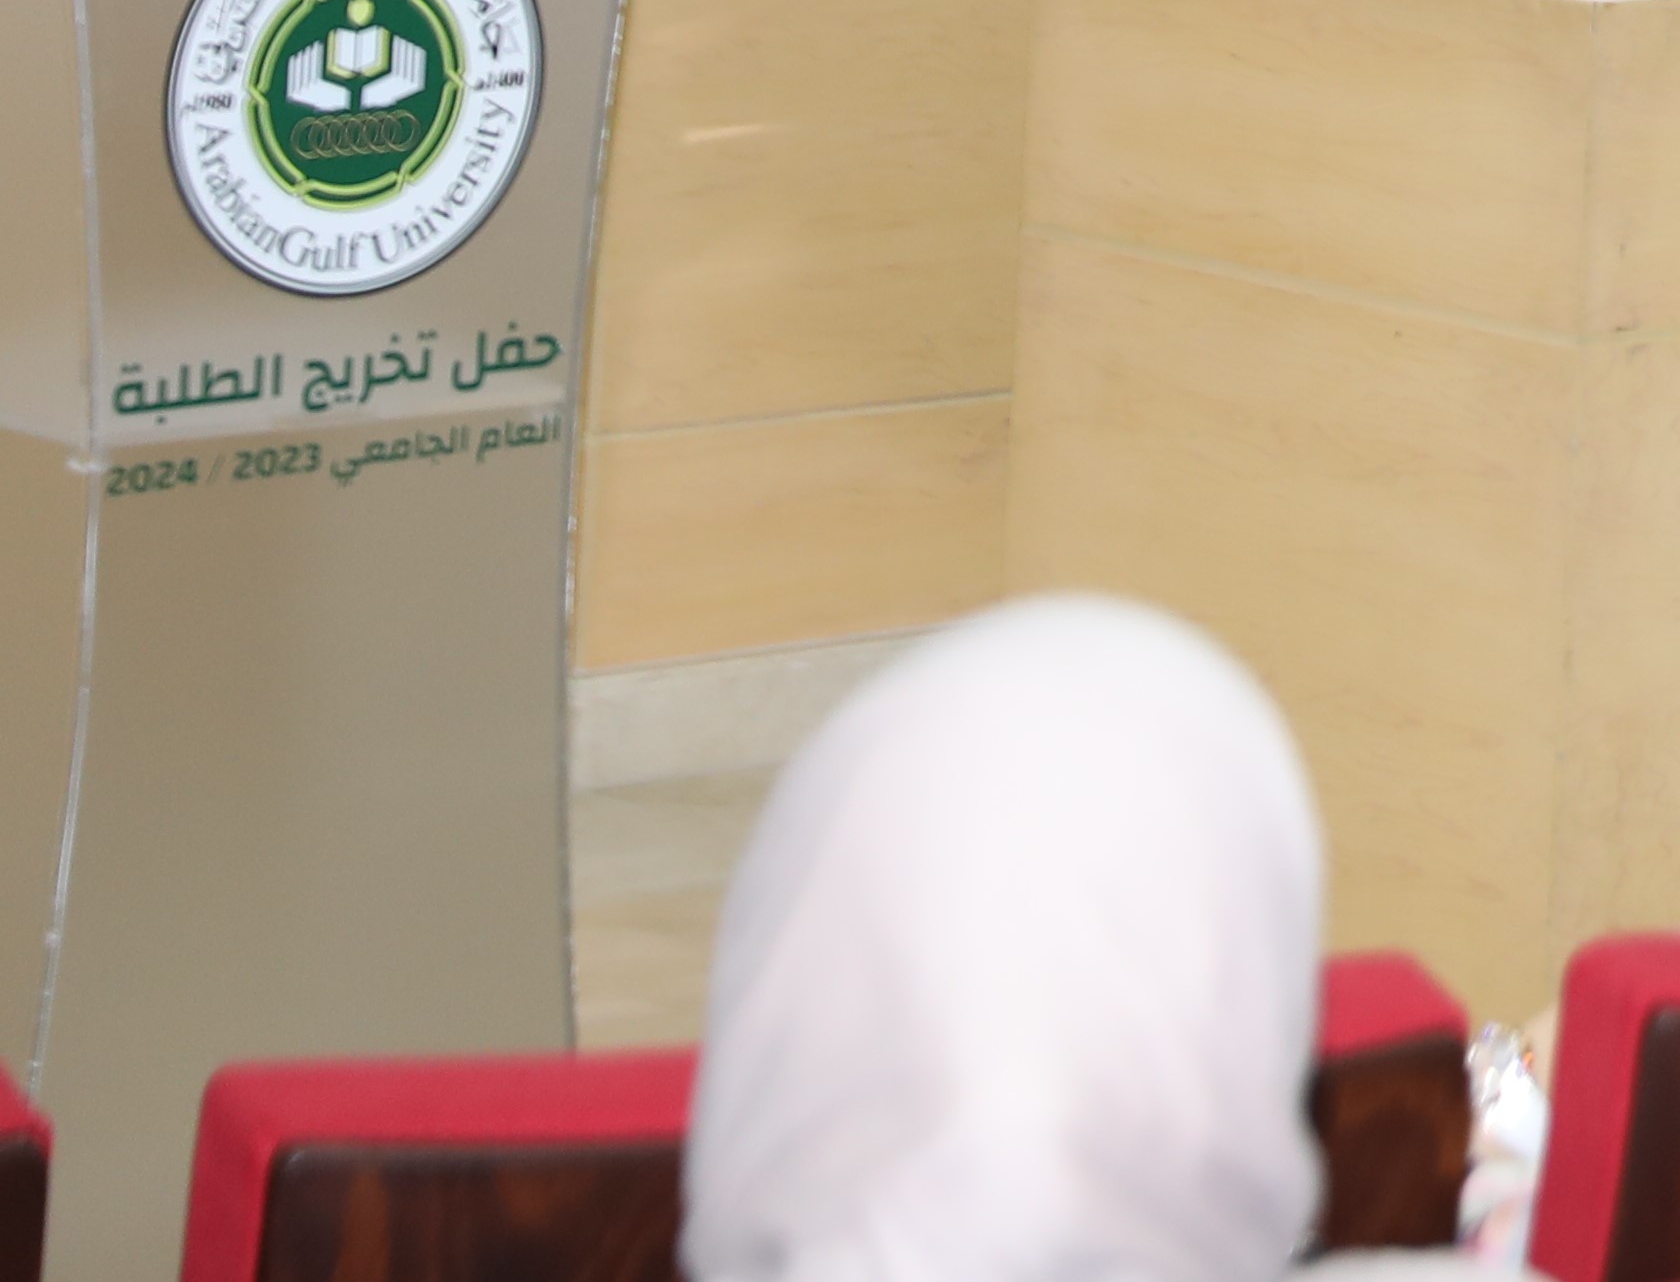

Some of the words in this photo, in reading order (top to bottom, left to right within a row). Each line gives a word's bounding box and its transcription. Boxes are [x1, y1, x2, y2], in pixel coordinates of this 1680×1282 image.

[195, 124, 277, 251] Arabian
[276, 227, 364, 271] Gulf
[371, 99, 516, 263] University
[112, 352, 285, 424] الطلبة
[301, 329, 438, 412] تخريج
[450, 320, 563, 392] حفل
[231, 442, 322, 482] 2023
[328, 425, 471, 488] الجامعي
[474, 413, 563, 464] العام
[106, 457, 199, 497] 2024
